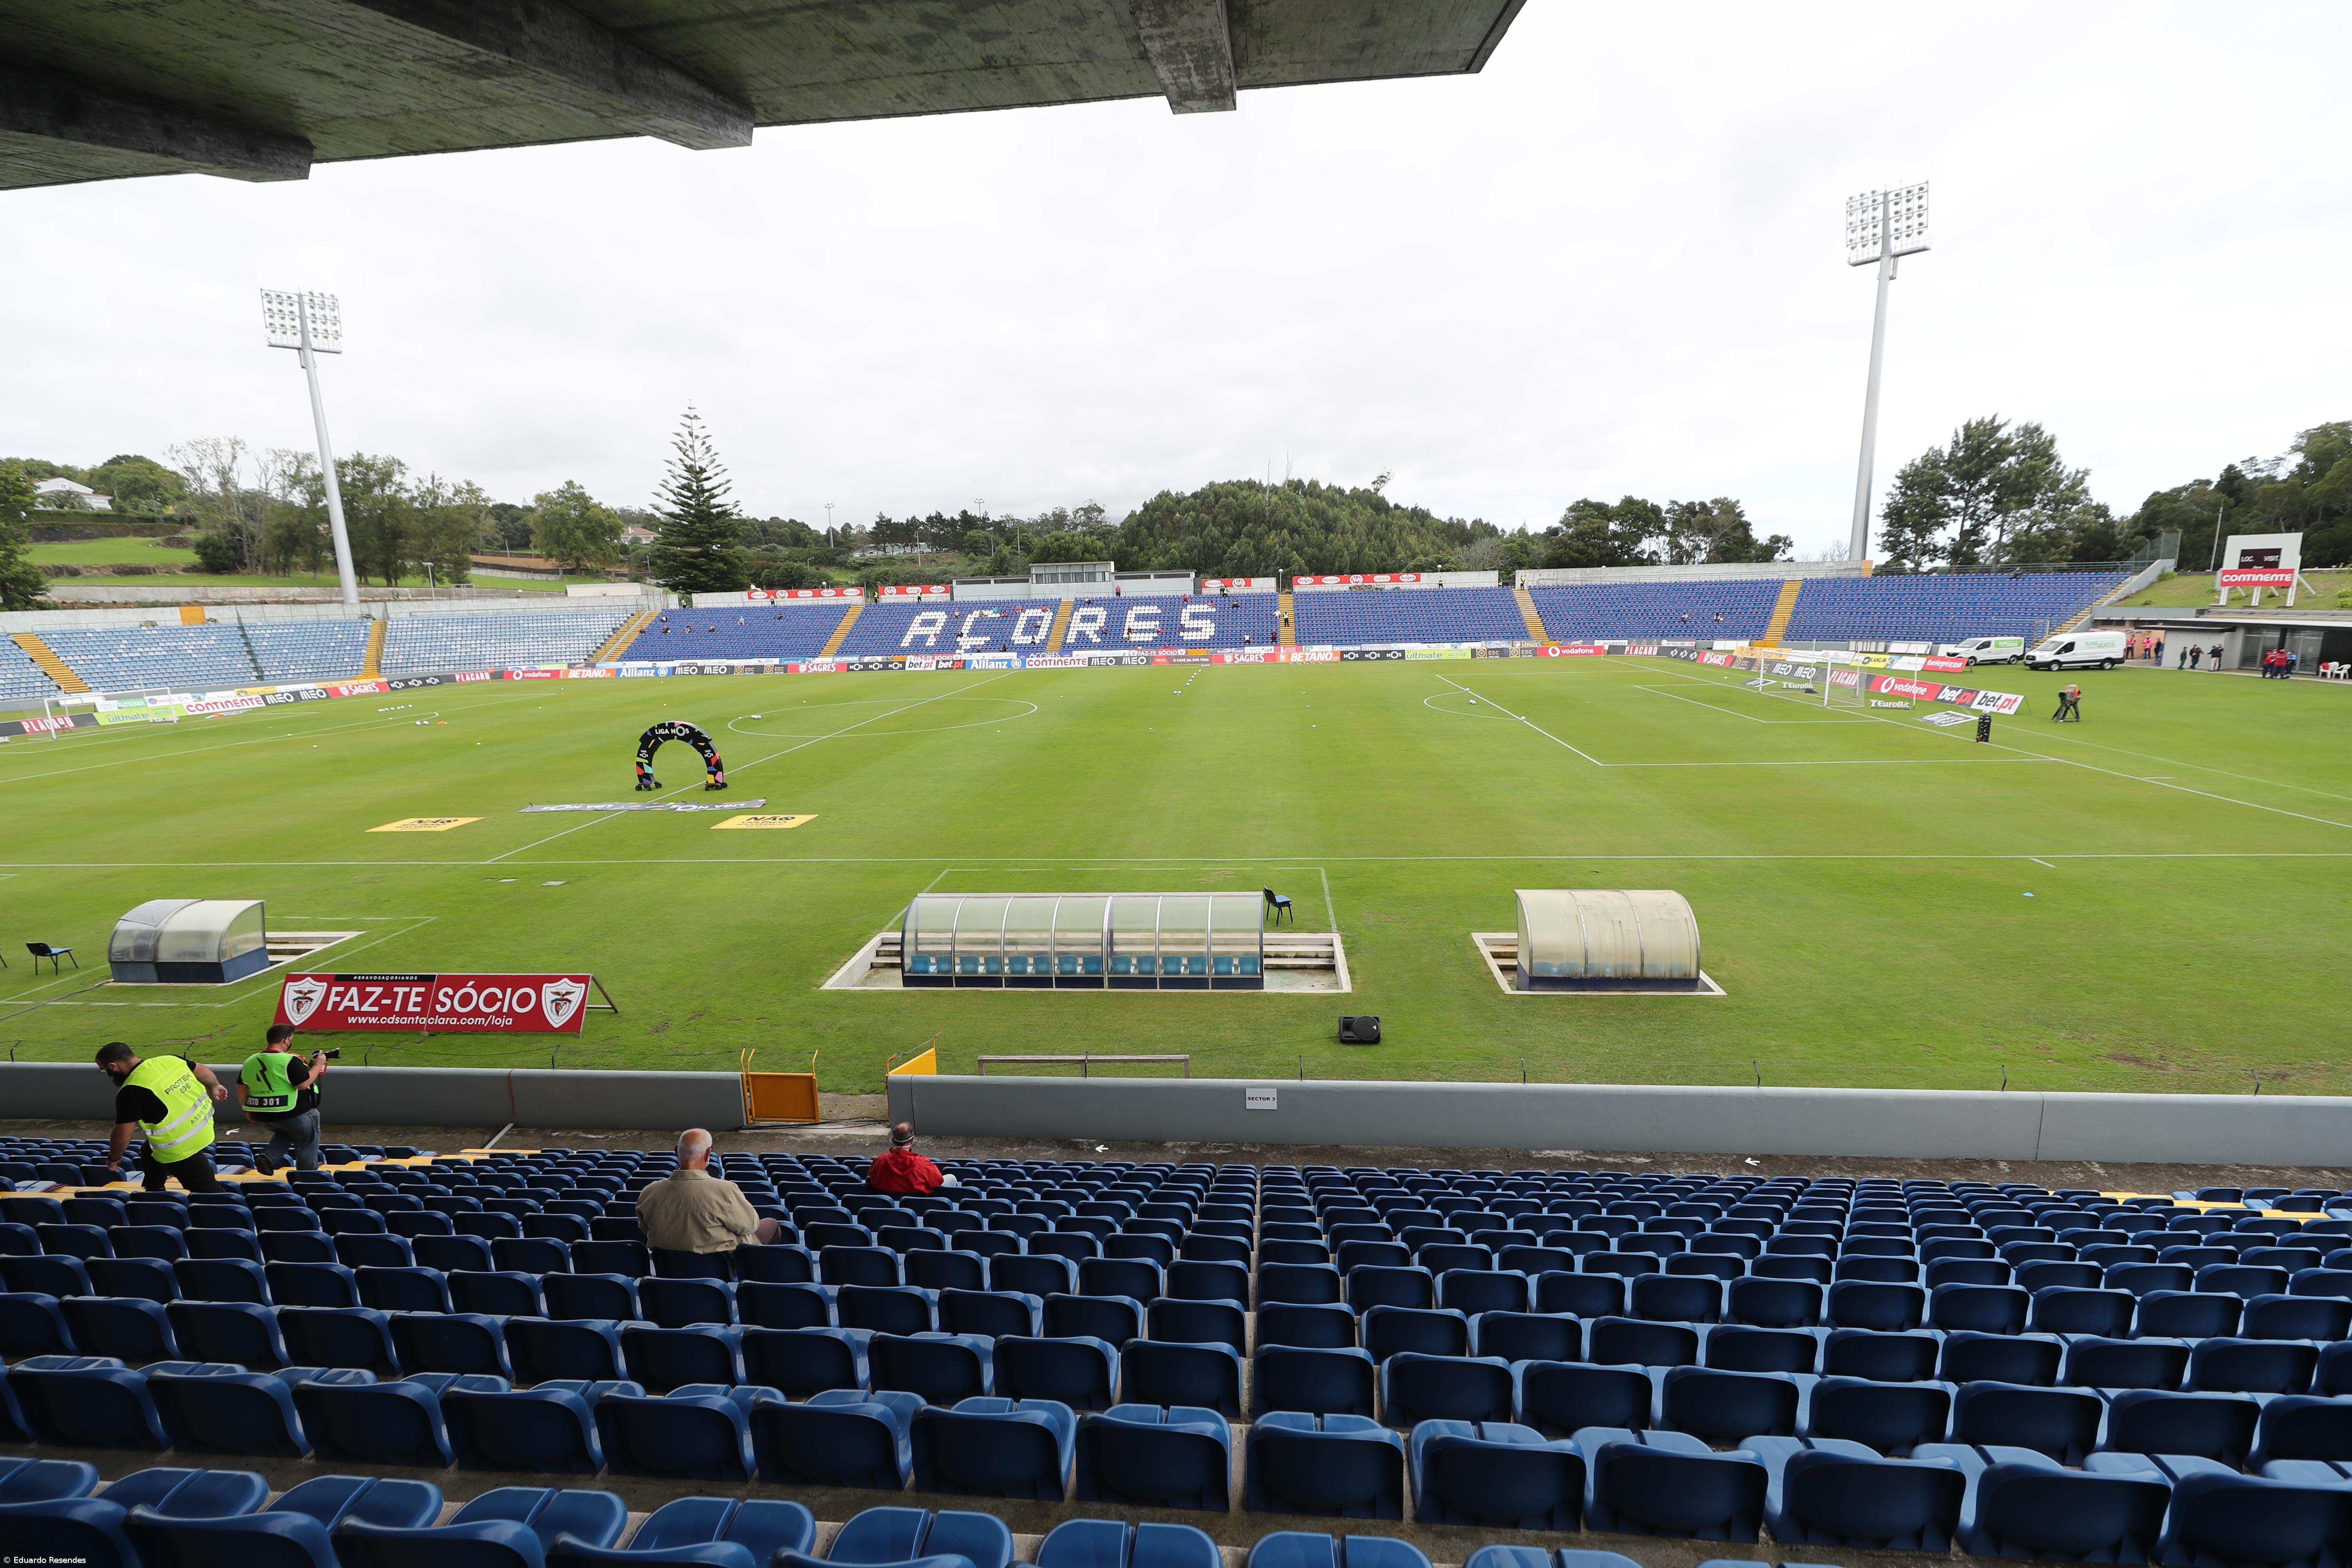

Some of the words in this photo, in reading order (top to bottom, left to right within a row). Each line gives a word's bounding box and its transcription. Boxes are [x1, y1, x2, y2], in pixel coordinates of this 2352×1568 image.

[2222, 573, 2293, 582] CONTINENTE
[1365, 651, 1381, 659] NOS
[1386, 651, 1402, 659] NOS
[1625, 646, 1658, 655] PLACARD
[1234, 653, 1265, 663] SAGRES
[1344, 652, 1359, 660] NOS
[1708, 652, 1727, 666] SAGRES
[869, 662, 883, 671] NOS
[908, 661, 933, 670] bet.pt
[938, 660, 965, 669] bet.pt
[971, 659, 1008, 669] Allianz
[1028, 658, 1087, 667] CONTINENTE
[1927, 659, 1963, 669] telepizza
[620, 667, 655, 677] Allianz
[808, 663, 836, 673] SAGRES
[455, 672, 490, 682] PLACARD
[1829, 671, 1860, 686] PLACARD
[349, 683, 380, 695] SAGRES
[1894, 683, 1927, 695] vodafone
[1938, 686, 1976, 705] bet.pt
[186, 697, 263, 713] CONTINENTE
[1879, 700, 1911, 708] EuroBic
[1977, 692, 2019, 711] bet.pt
[106, 712, 148, 723] ultimate
[21, 716, 75, 732] PLACARD
[671, 726, 689, 736] NOS
[326, 986, 426, 1012] FAZ-TE
[435, 981, 536, 1013] SÓCIO
[348, 1014, 513, 1027] www.cdsantaclara.com/loja
[164, 1072, 192, 1095] PROTEK
[263, 1098, 279, 1106] 301
